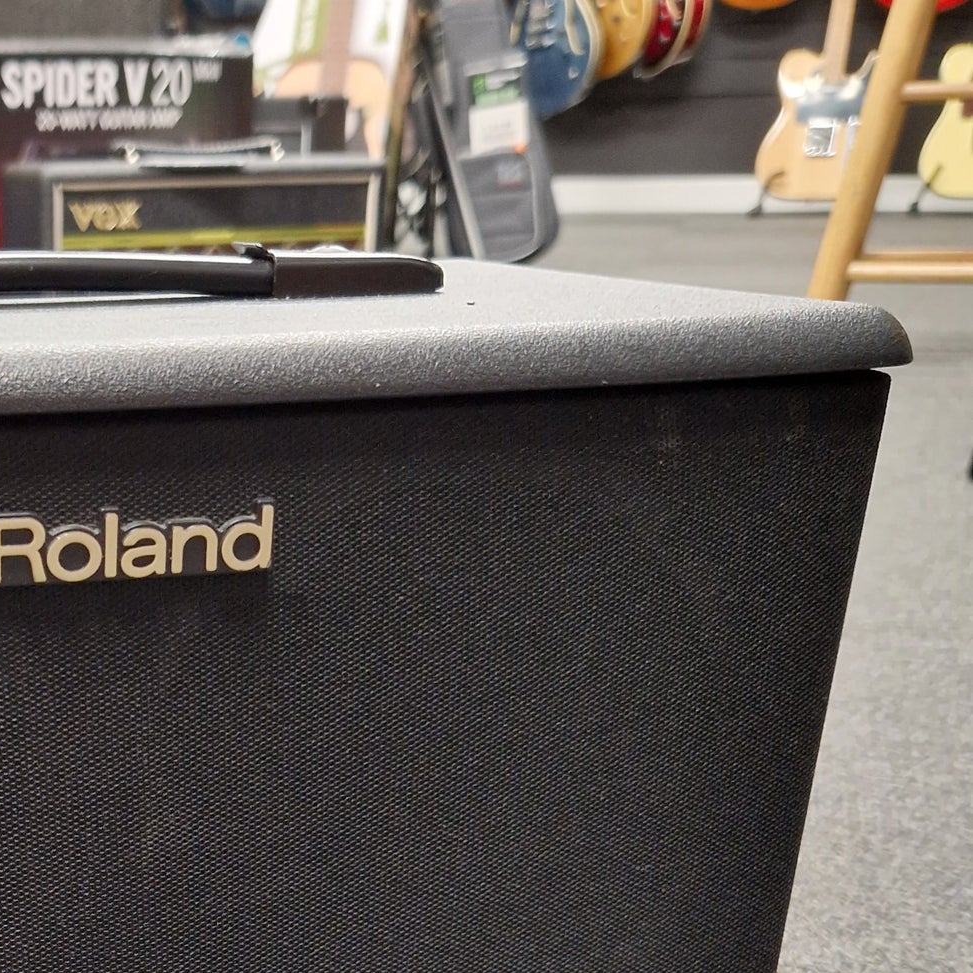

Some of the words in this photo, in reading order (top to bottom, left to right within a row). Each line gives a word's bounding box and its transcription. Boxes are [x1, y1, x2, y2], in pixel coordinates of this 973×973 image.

[0, 58, 119, 108] SPIDER
[123, 58, 149, 106] V
[151, 57, 193, 106] 20
[68, 201, 143, 232] VOX
